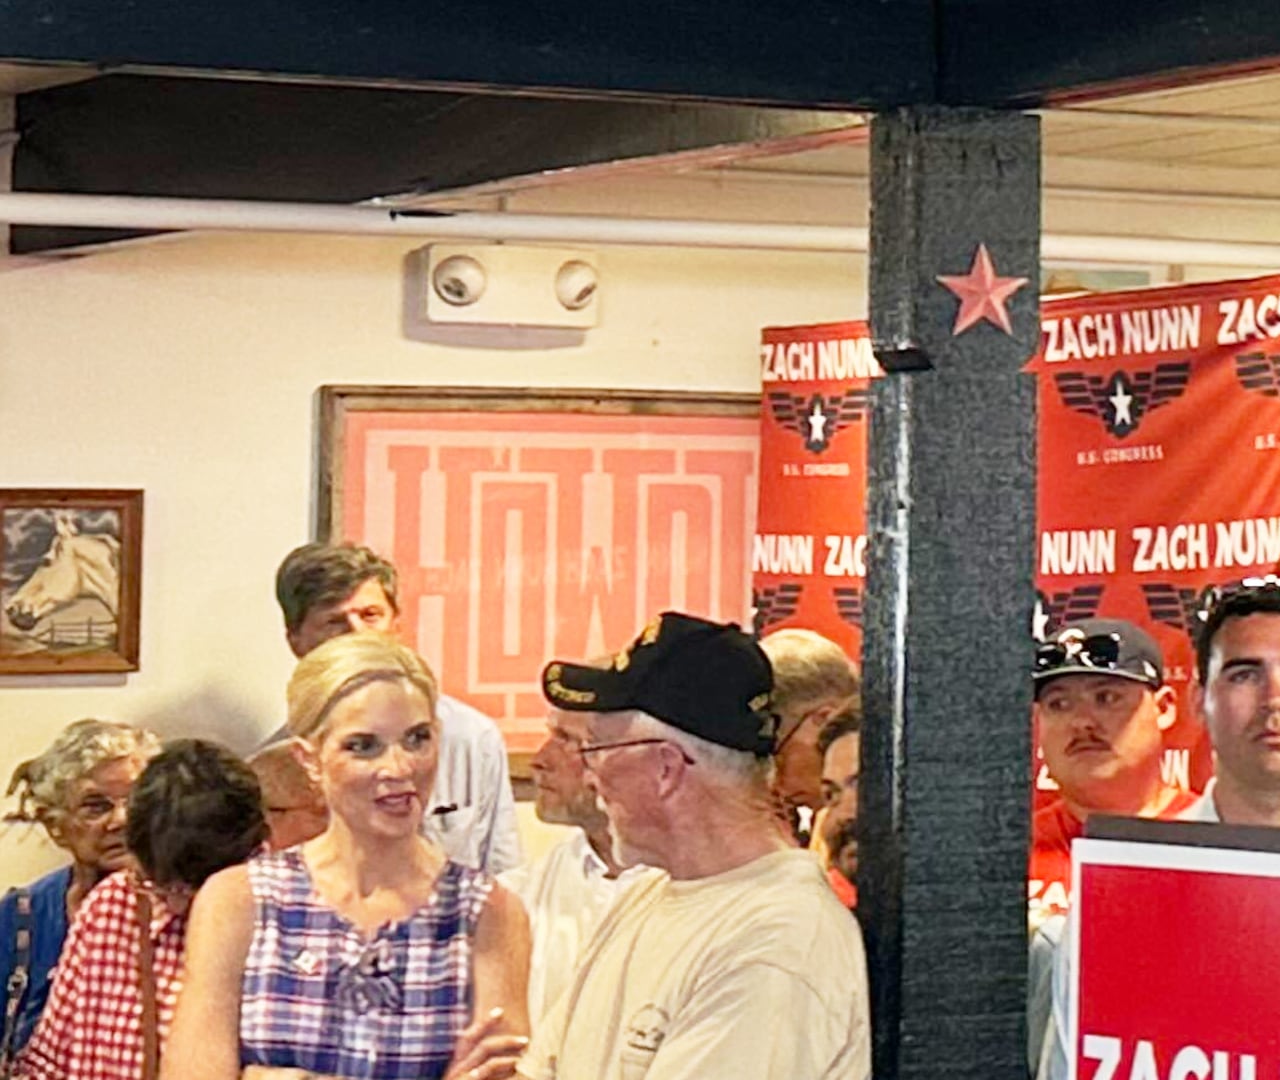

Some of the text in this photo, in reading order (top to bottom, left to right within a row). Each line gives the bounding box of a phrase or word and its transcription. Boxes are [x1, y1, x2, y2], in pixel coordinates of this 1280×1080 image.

[1042, 313, 1119, 362] ZACH
[1120, 305, 1202, 354] NUNN
[761, 342, 814, 381] ZACH
[753, 534, 813, 575] NUNN
[1041, 530, 1117, 575] NUNN
[1132, 522, 1210, 573] ZACH
